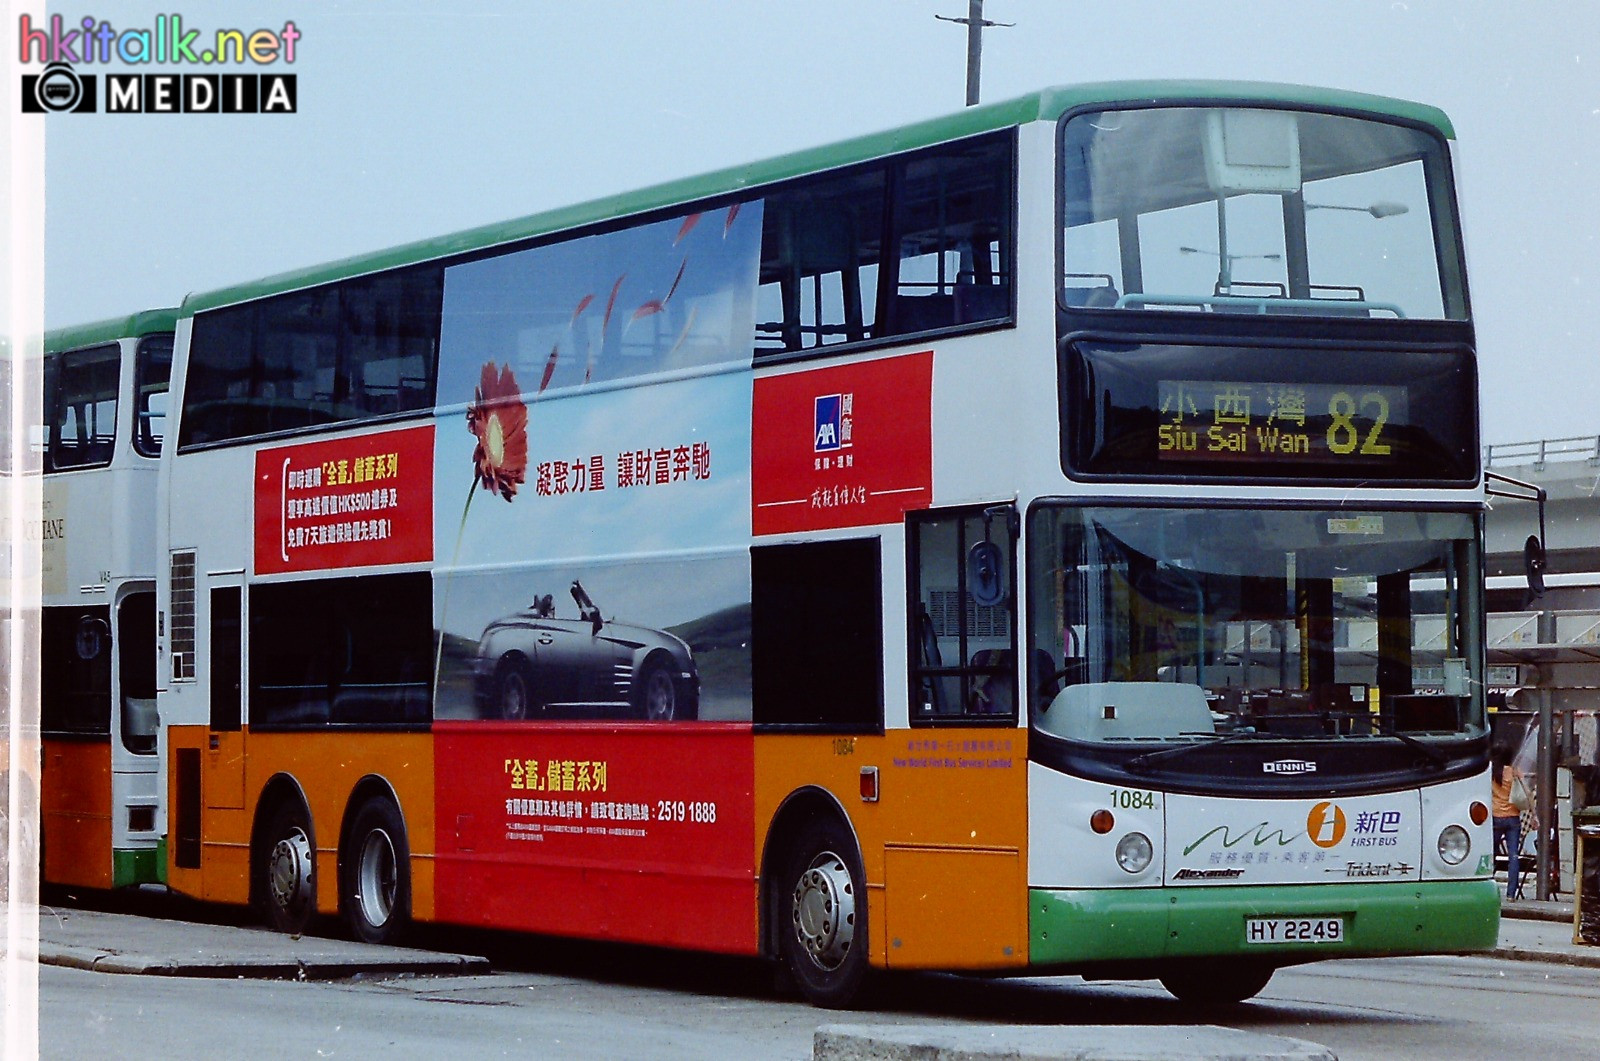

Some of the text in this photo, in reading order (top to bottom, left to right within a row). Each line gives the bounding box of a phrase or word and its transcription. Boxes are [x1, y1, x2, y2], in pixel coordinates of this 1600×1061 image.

[1160, 383, 1305, 426] 小西灣
[1326, 392, 1391, 455] 82
[1158, 424, 1309, 453] Siu Sai Wan
[536, 441, 711, 496] 凝聚力量 讓財富奔馳
[1263, 761, 1317, 773] DENNIS
[1109, 789, 1155, 810] 1084
[657, 800, 686, 822] 2519
[688, 801, 717, 824] 1888
[1353, 811, 1401, 834] 新巴
[1351, 836, 1398, 847] FIRST BUS
[1172, 868, 1245, 881] Alexander
[1346, 861, 1392, 877] Trident
[1251, 920, 1341, 940] HY 2249
